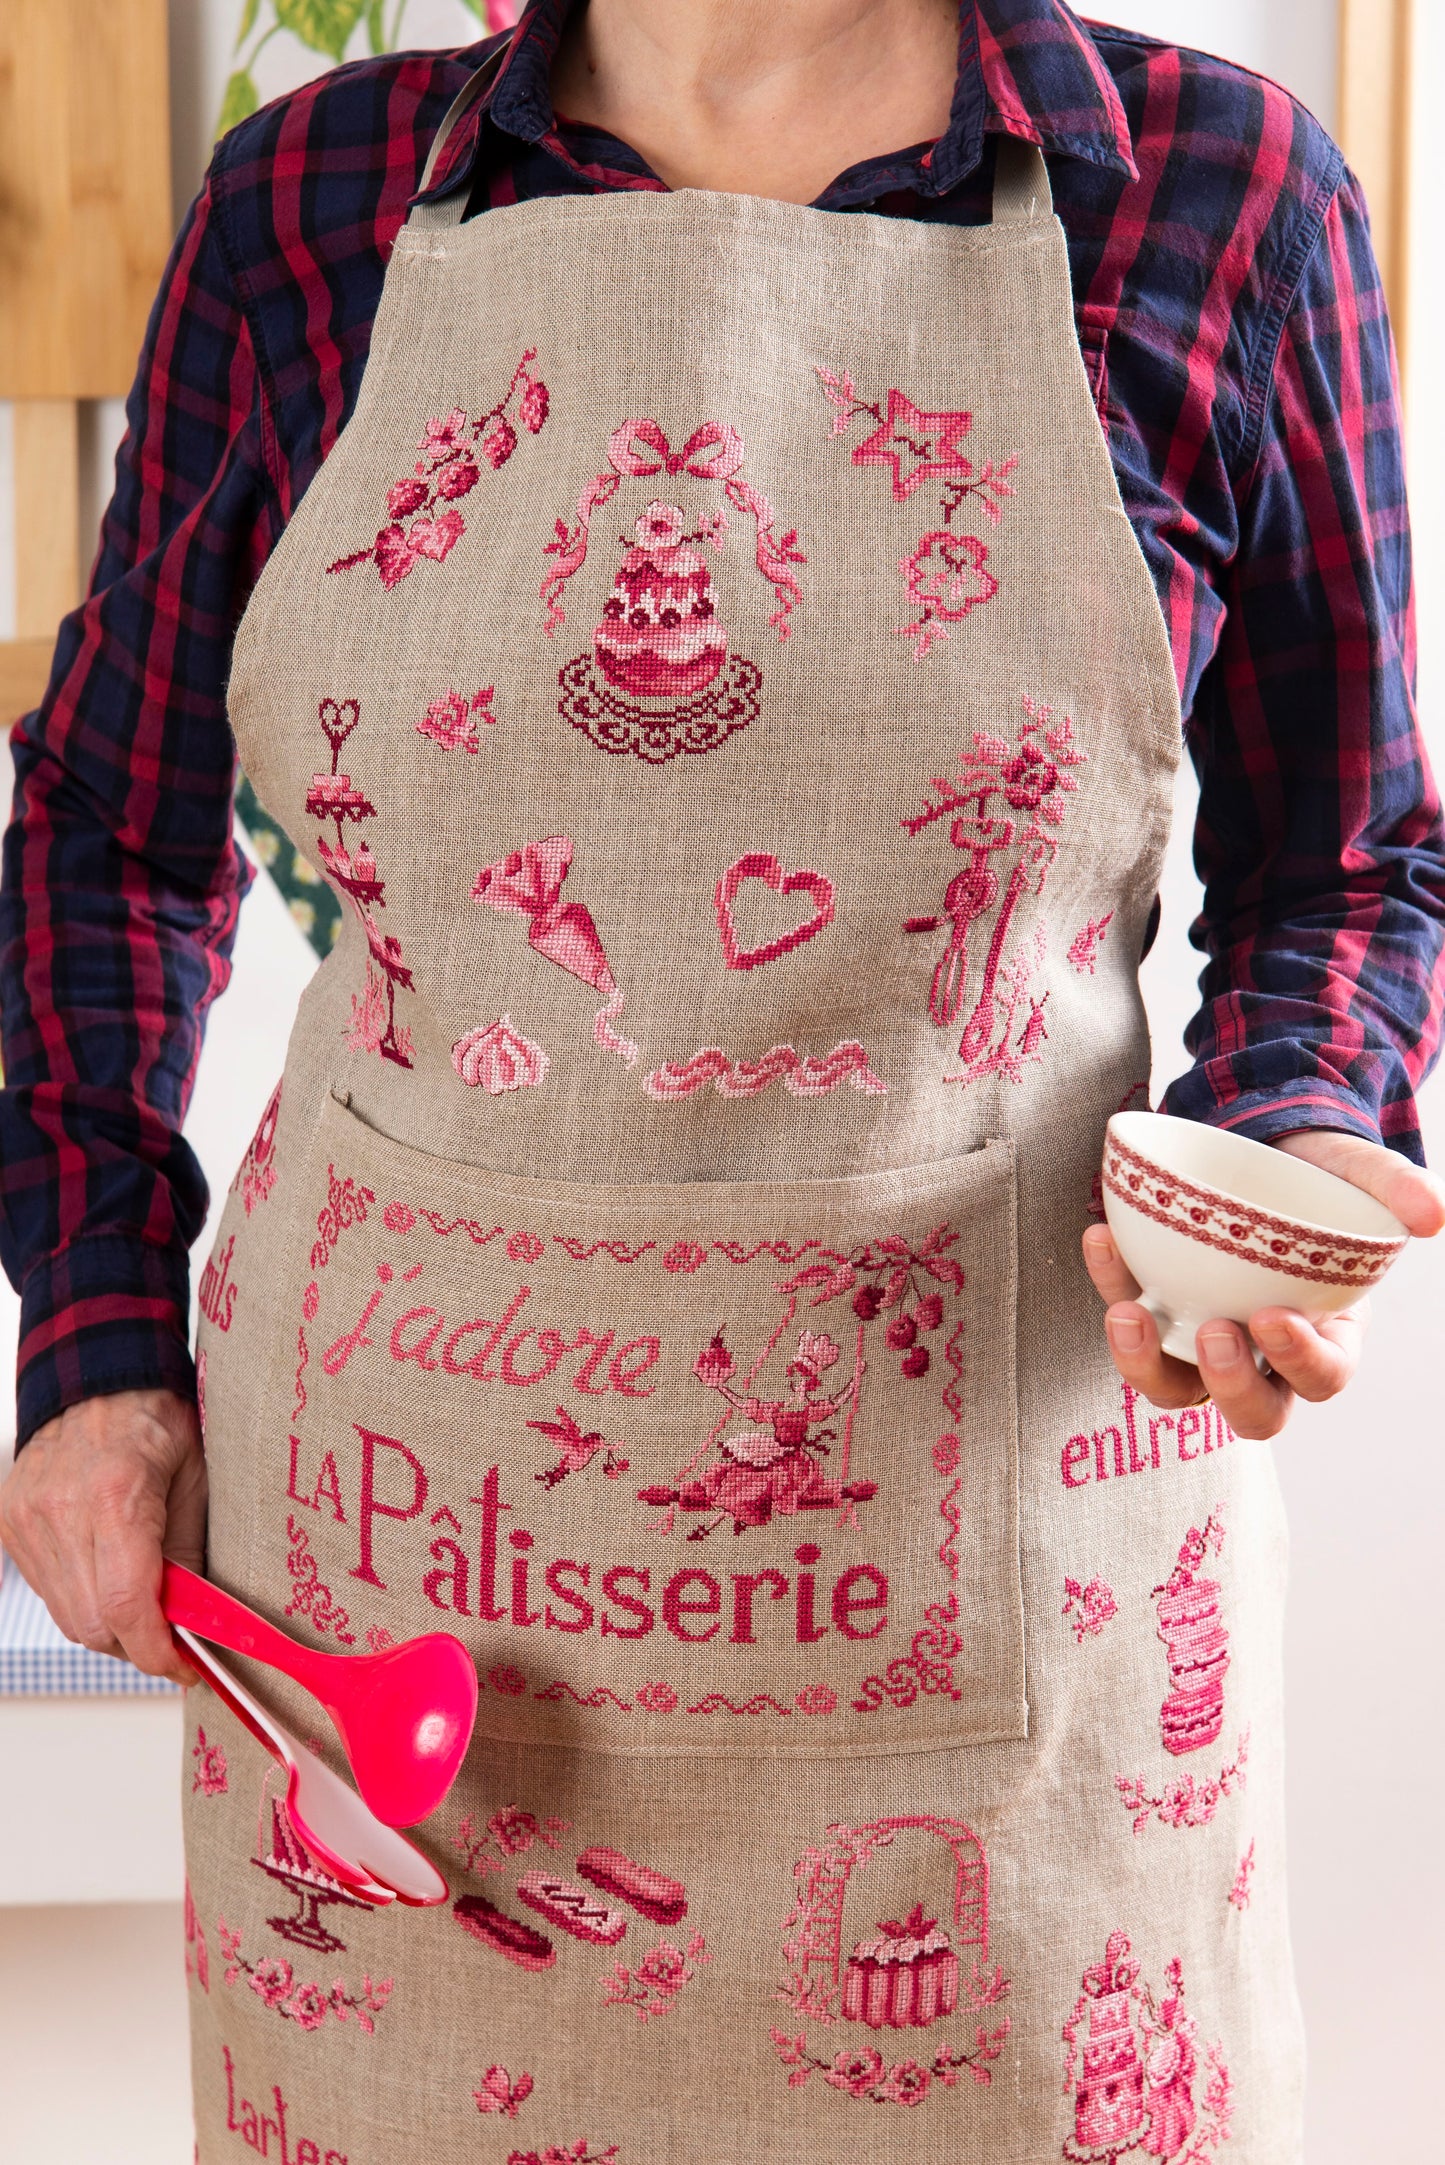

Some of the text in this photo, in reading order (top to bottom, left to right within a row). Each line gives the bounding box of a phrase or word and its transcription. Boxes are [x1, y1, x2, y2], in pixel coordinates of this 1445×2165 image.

[322, 1263, 661, 1397] j'adore
[286, 1423, 889, 1644] LA Pâtisserie
